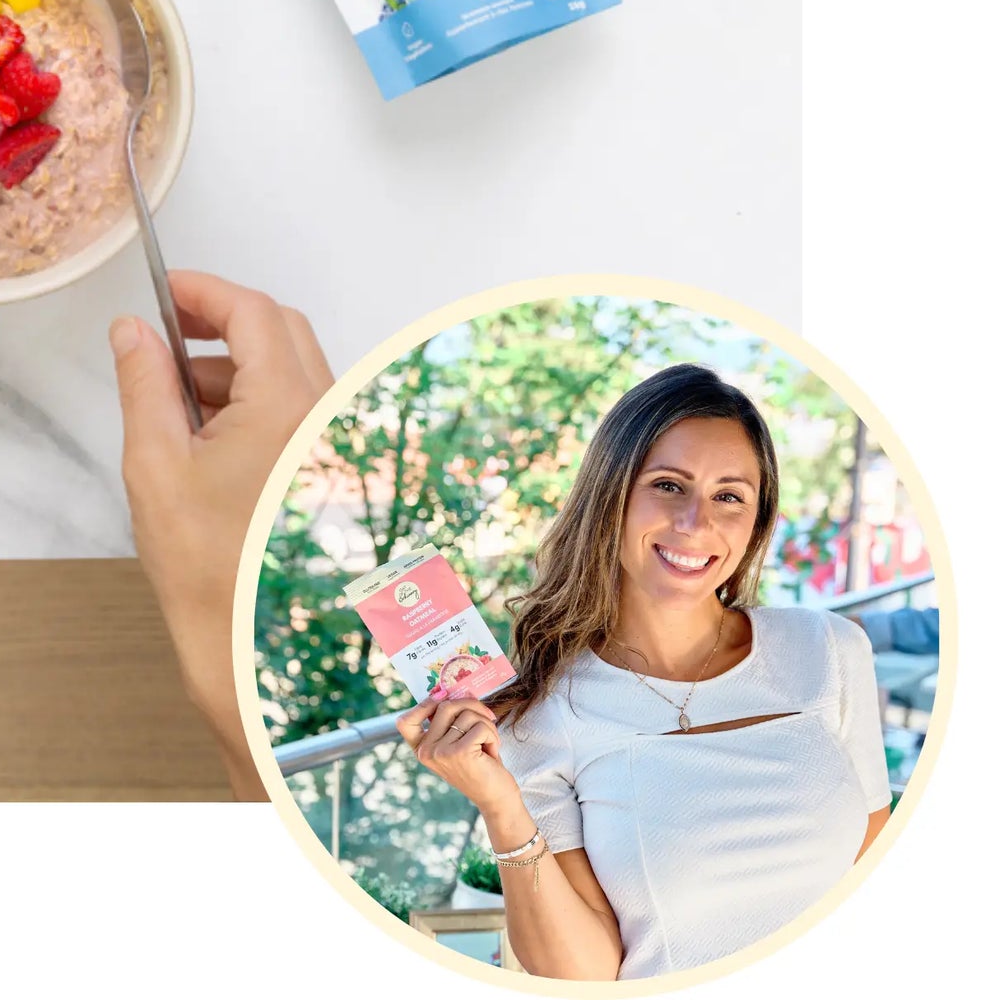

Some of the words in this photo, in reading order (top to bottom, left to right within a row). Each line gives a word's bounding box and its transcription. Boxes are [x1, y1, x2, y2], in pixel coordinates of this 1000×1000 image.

[450, 624, 461, 633] 4g
[426, 638, 438, 649] 11g
[406, 651, 418, 661] 7g
